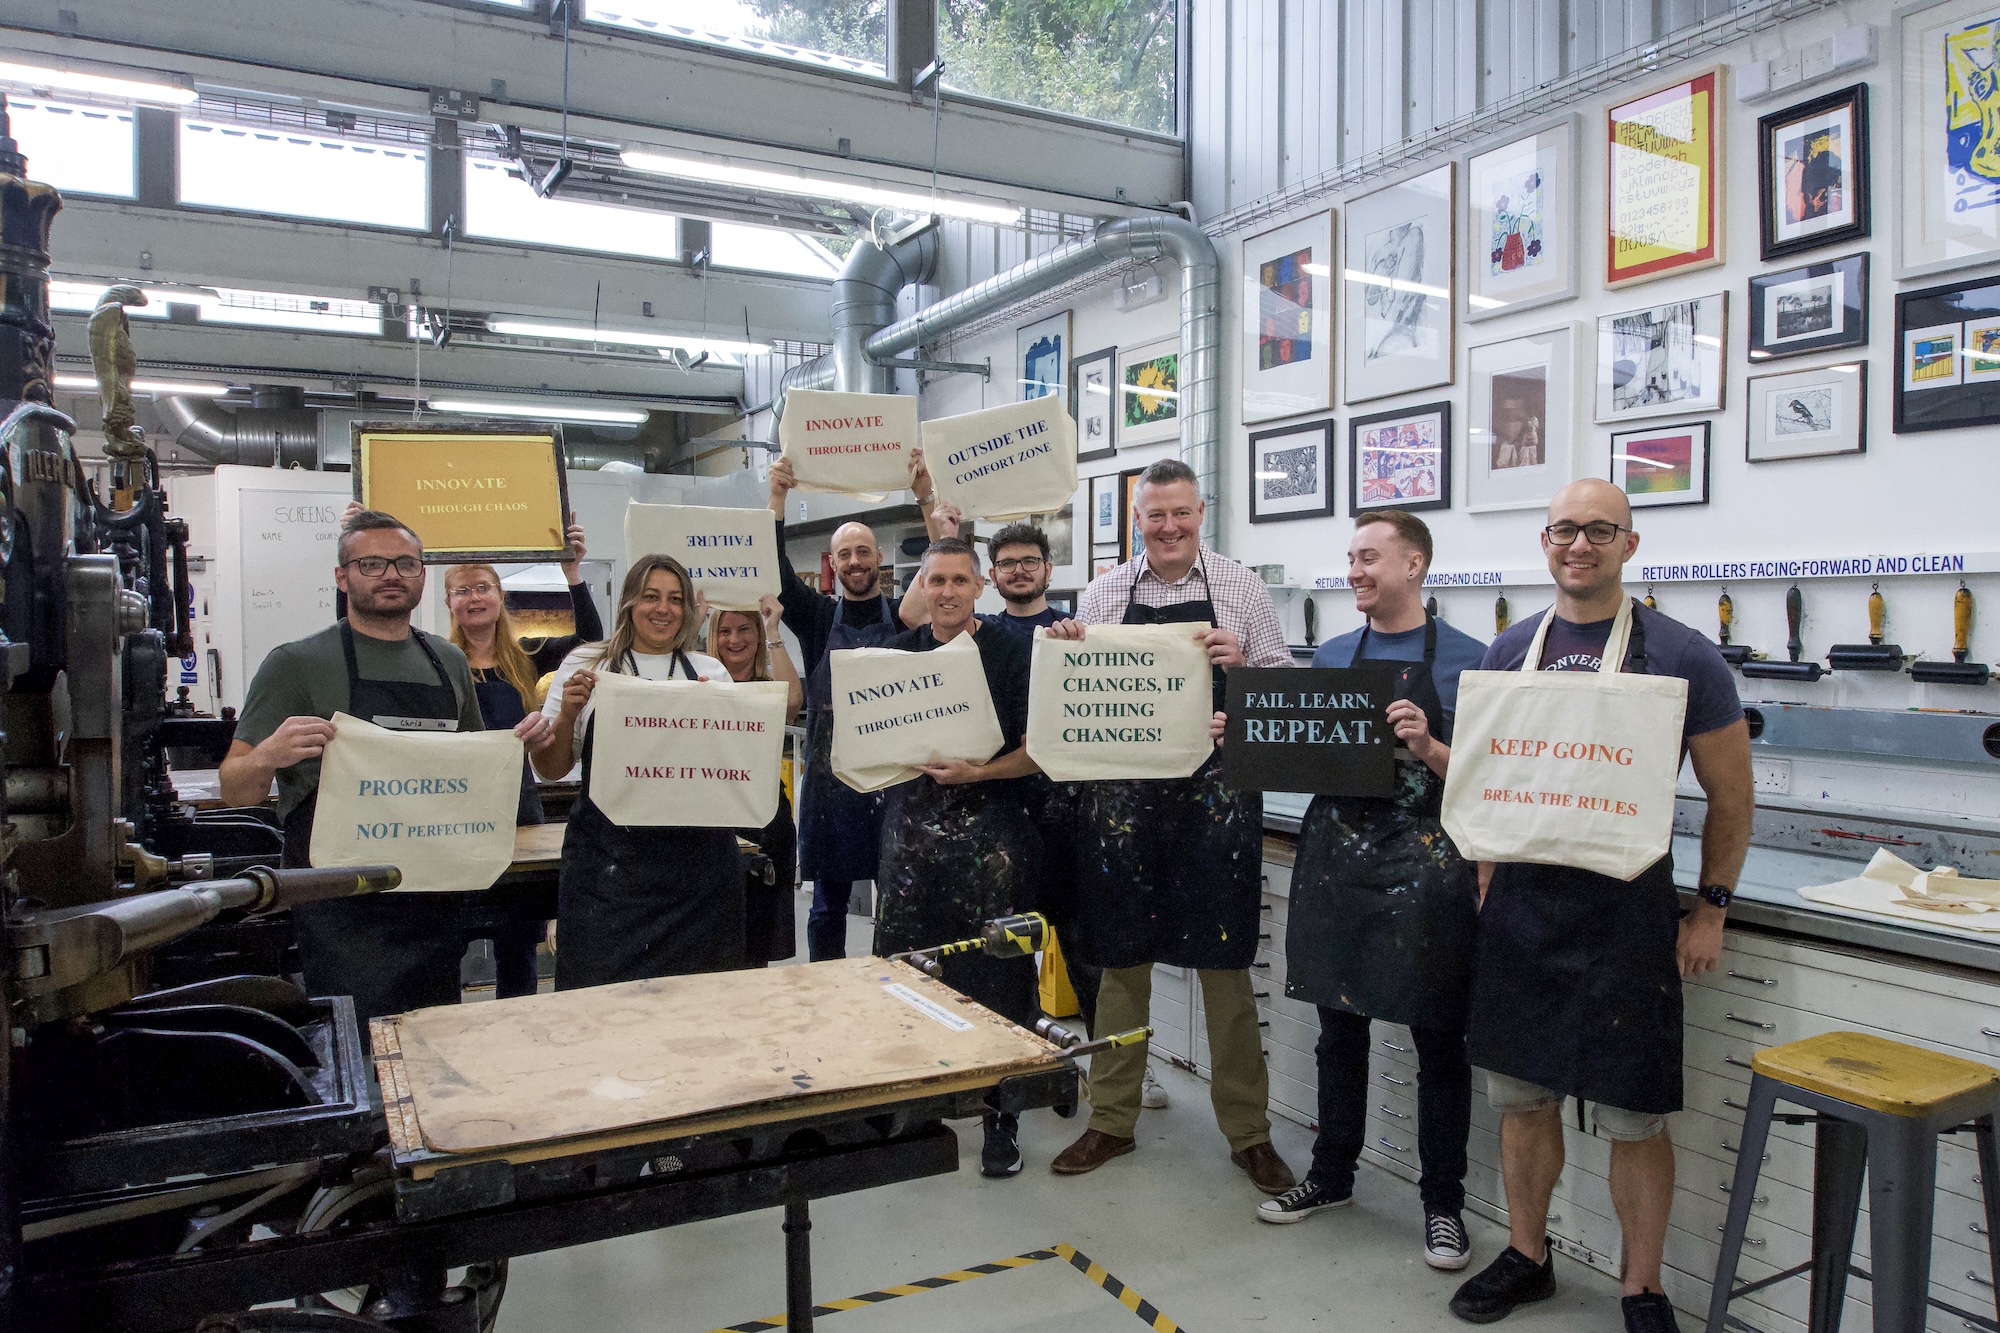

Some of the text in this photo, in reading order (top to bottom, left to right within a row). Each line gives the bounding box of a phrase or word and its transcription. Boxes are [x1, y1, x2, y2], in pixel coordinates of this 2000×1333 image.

[805, 415, 884, 431] INNOVATE
[806, 441, 901, 456] THROUGH CHAOS
[948, 419, 1049, 466] OUTSIDE THE
[955, 441, 1052, 485] COMFORT ZONE
[416, 477, 507, 491] INNOVATE
[274, 506, 336, 523] SCREENS
[418, 502, 528, 514] THROUGH CHAOS
[261, 532, 340, 541] NAME COURS
[686, 535, 753, 547] FAILURE
[707, 566, 758, 578] LEARN
[1642, 555, 1963, 580] RETURN ROLLERS FACING FORWARD AND CLEAN
[1317, 577, 1345, 588] RETURN
[1423, 573, 1450, 585] WARD
[1451, 573, 1470, 585] AND
[1472, 572, 1502, 585] CLEAN
[1063, 651, 1155, 667] NOTHING
[848, 673, 944, 705] INNOVATE
[1063, 677, 1186, 694] CHANGES, IF
[1244, 692, 1375, 709] FAIL. LEARN.
[855, 702, 970, 736] THROUGH CHAOS
[1063, 703, 1155, 718] NOTHING
[400, 719, 422, 727] Chris
[624, 716, 765, 733] EMBRACE FAILURE
[1244, 718, 1381, 745] REPEAT.
[1062, 727, 1162, 743] CHANGES!
[1489, 738, 1634, 766] KEEP GOING
[625, 766, 752, 781] MAKE IT WORK
[358, 777, 468, 797] PROGRESS
[1483, 788, 1638, 816] BREAK THE RULES
[356, 821, 496, 840] NOT PERFECTION
